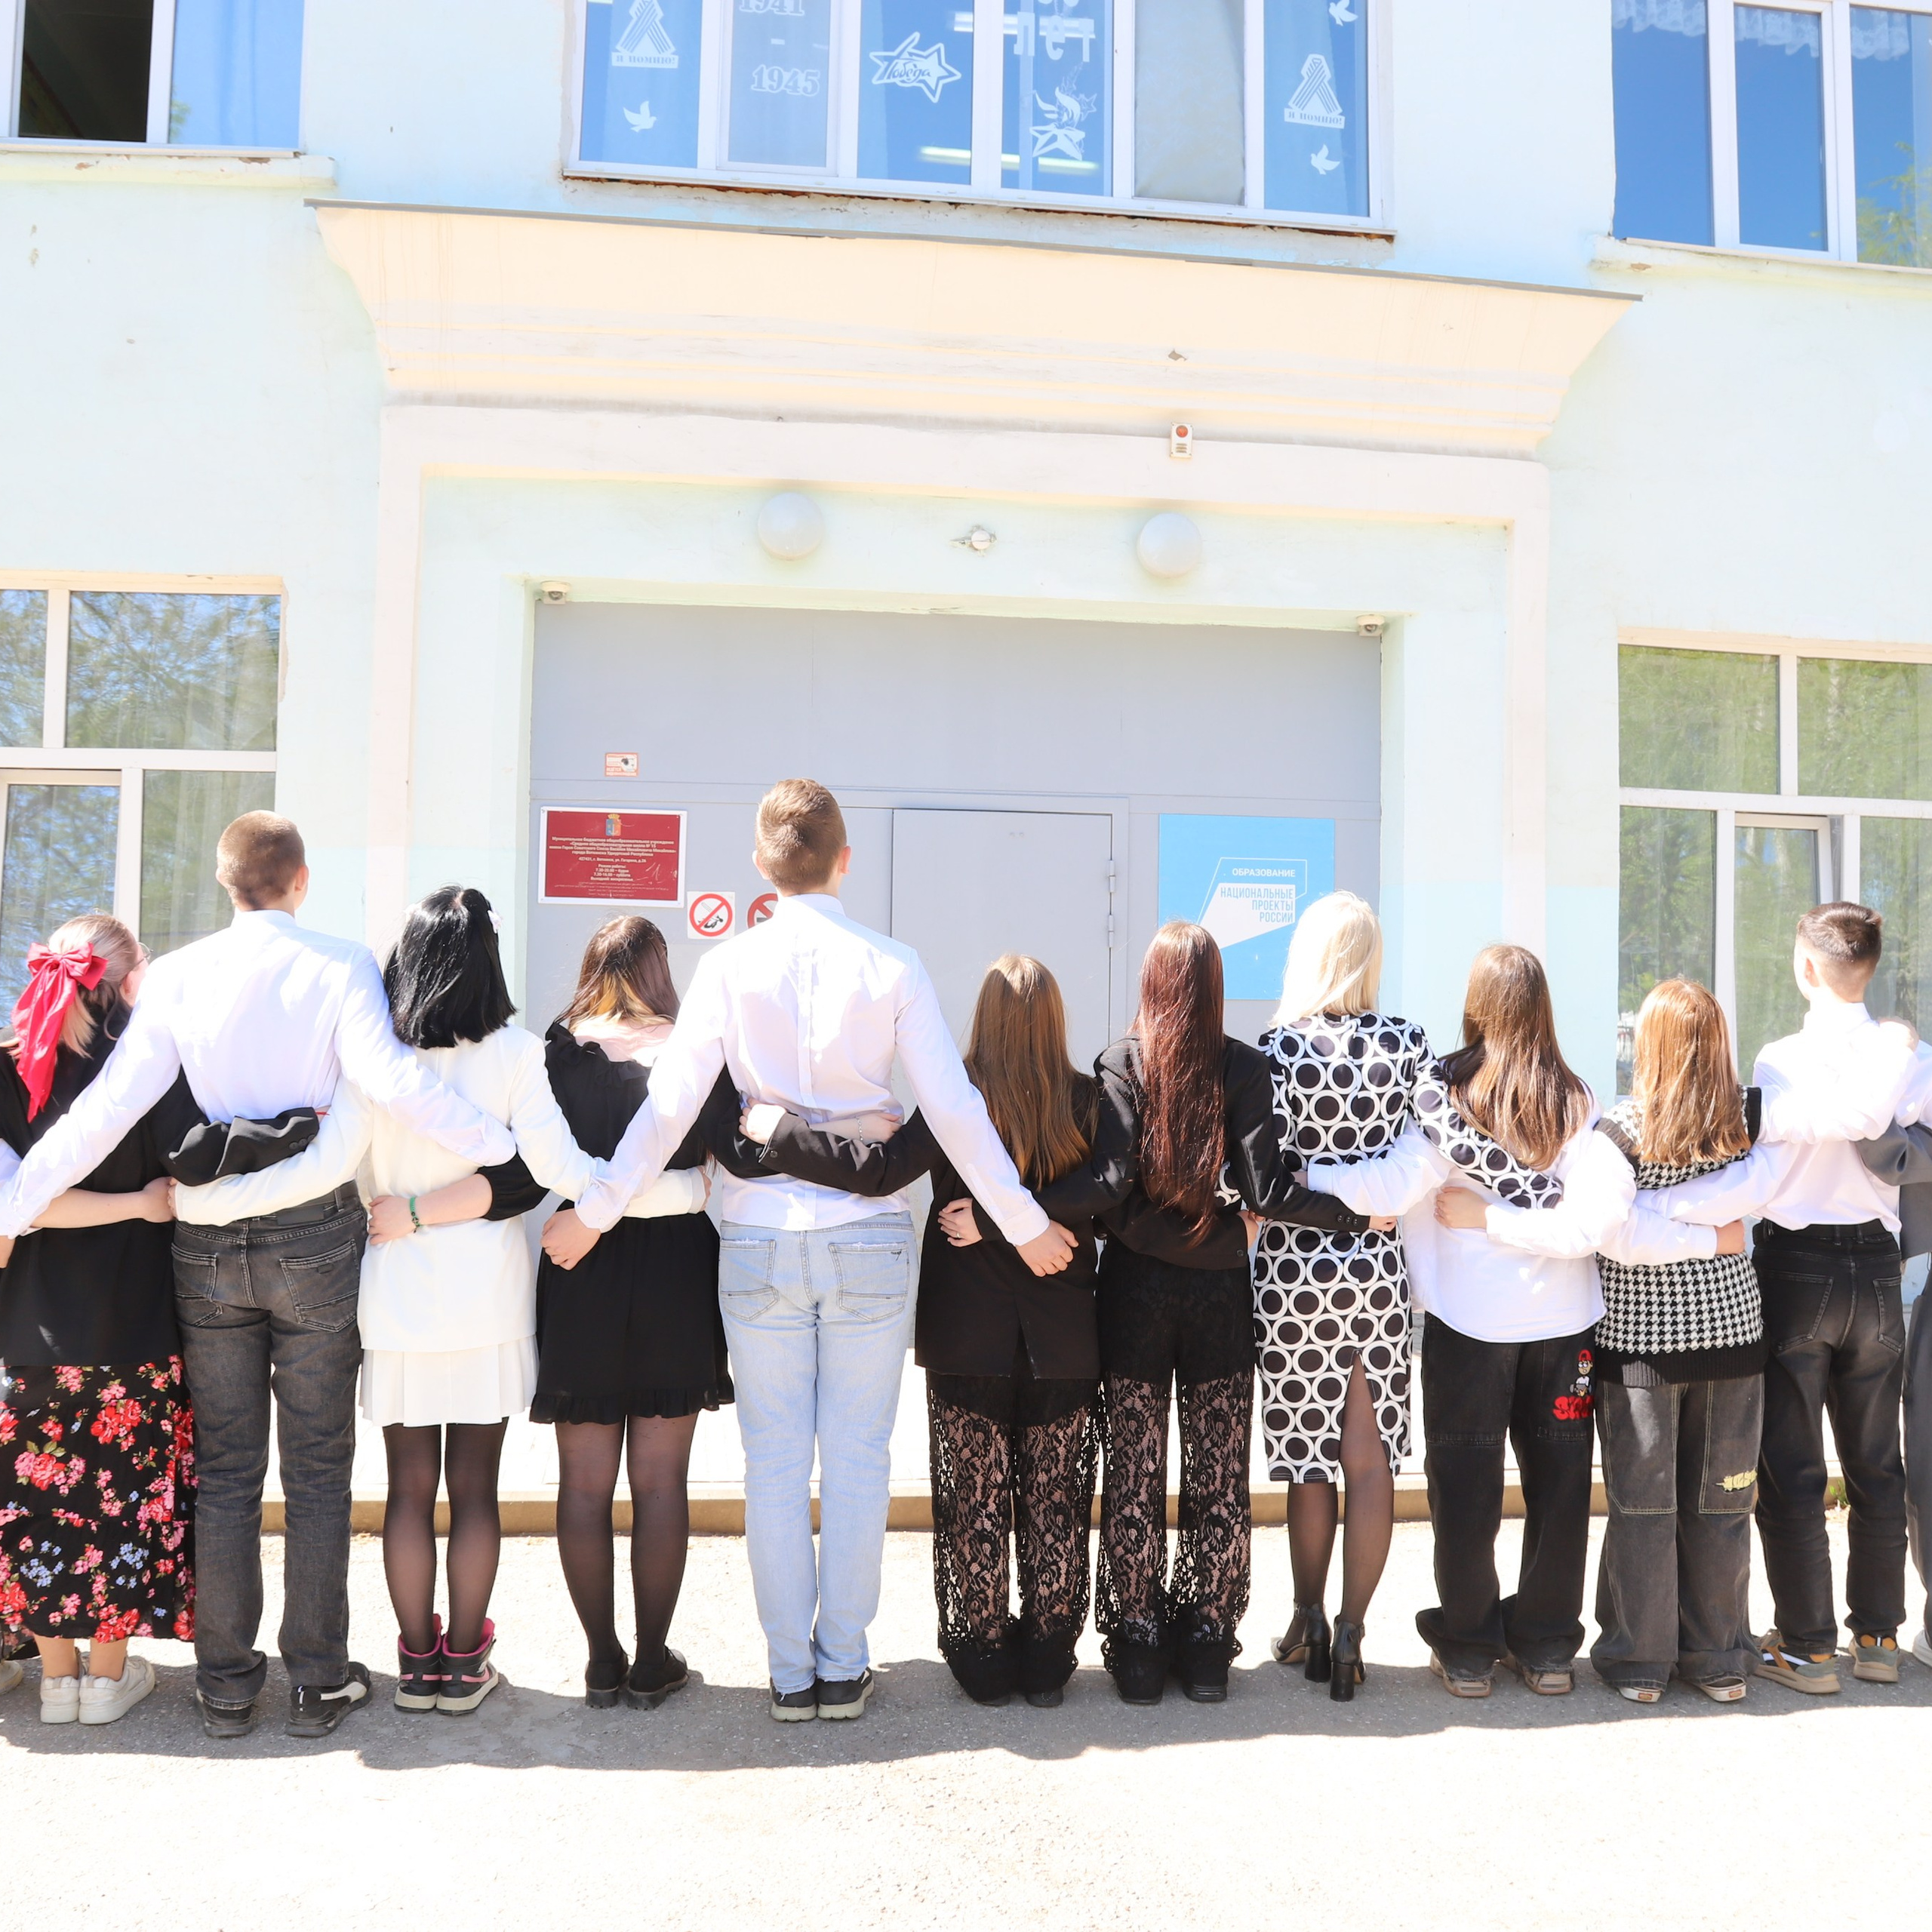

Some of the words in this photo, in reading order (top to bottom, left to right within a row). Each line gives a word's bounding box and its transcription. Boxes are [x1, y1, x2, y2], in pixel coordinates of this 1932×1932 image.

[1014, 11, 1094, 63] лет
[751, 64, 820, 97] 1945
[1232, 868, 1296, 878] ОБРАЗОВАНИЕ
[1220, 887, 1294, 900] НАЦИОНАЛЬНЫЕ
[1251, 900, 1294, 911] ПРОЕКТЫ
[1259, 912, 1294, 923] РОССИИ
